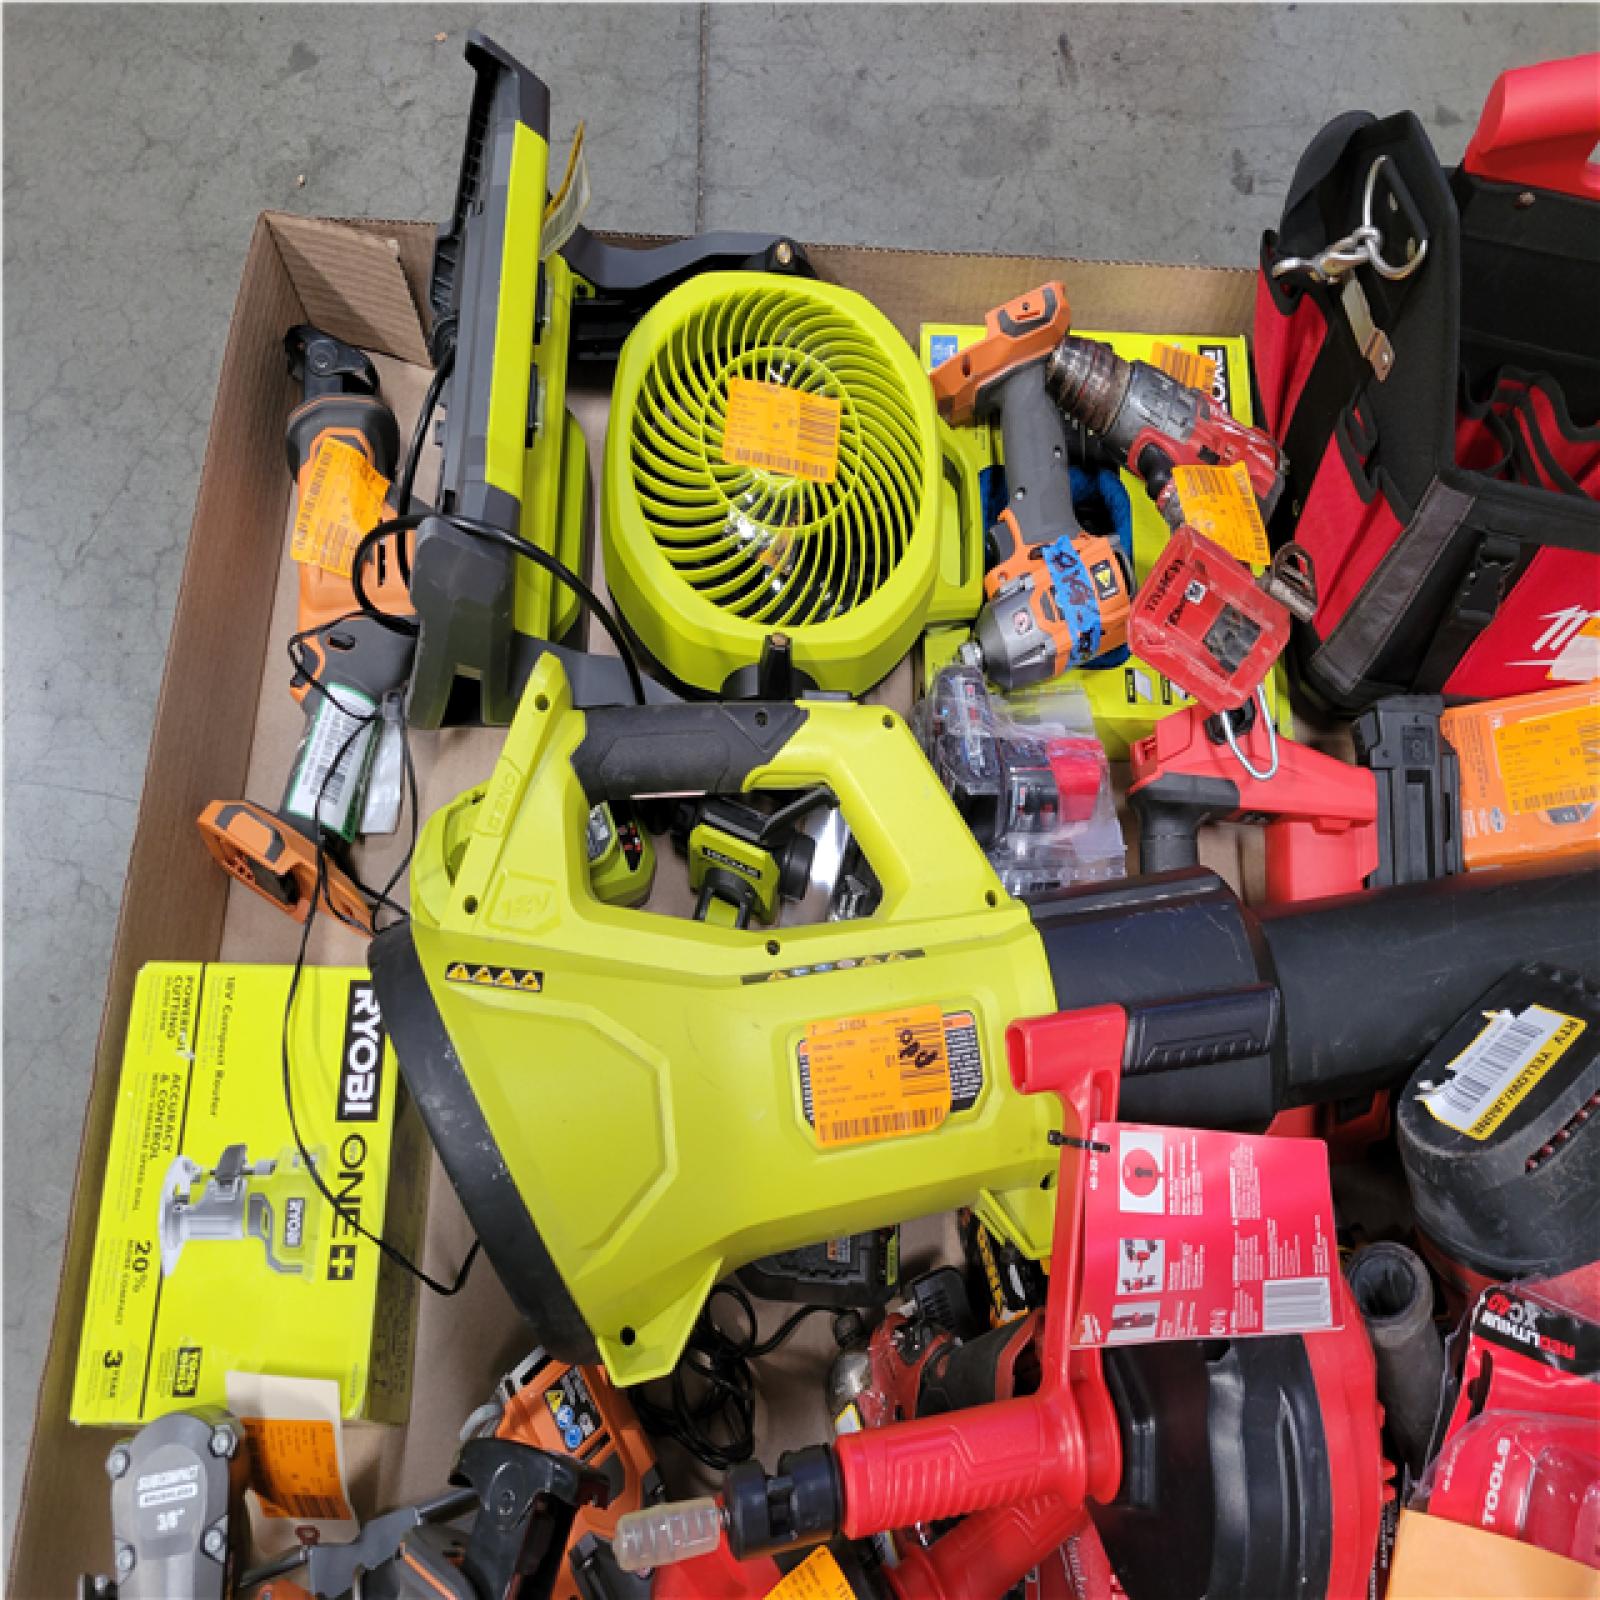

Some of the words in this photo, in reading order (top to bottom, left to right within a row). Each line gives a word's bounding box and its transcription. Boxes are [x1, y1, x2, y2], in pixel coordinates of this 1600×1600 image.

[166, 974, 184, 1040] CUTTING
[177, 974, 194, 1052] POWERFUL
[223, 975, 236, 1001] 18V
[214, 1003, 234, 1067] Compact
[343, 987, 383, 1117] RYOBI
[1552, 1019, 1580, 1046] RTV
[160, 1072, 171, 1084] &
[208, 1068, 225, 1117] Router
[150, 1086, 169, 1160] CONTROL
[164, 1071, 182, 1154] ACCURACY
[285, 1199, 303, 1246] RYOBI
[125, 1239, 136, 1270] MORE
[131, 1239, 152, 1294] 20%
[114, 1271, 130, 1326] COMPACT
[103, 1349, 124, 1369] 3
[136, 1464, 200, 1492] SUBCOMPACT
[1482, 1436, 1511, 1525] TOOLS
